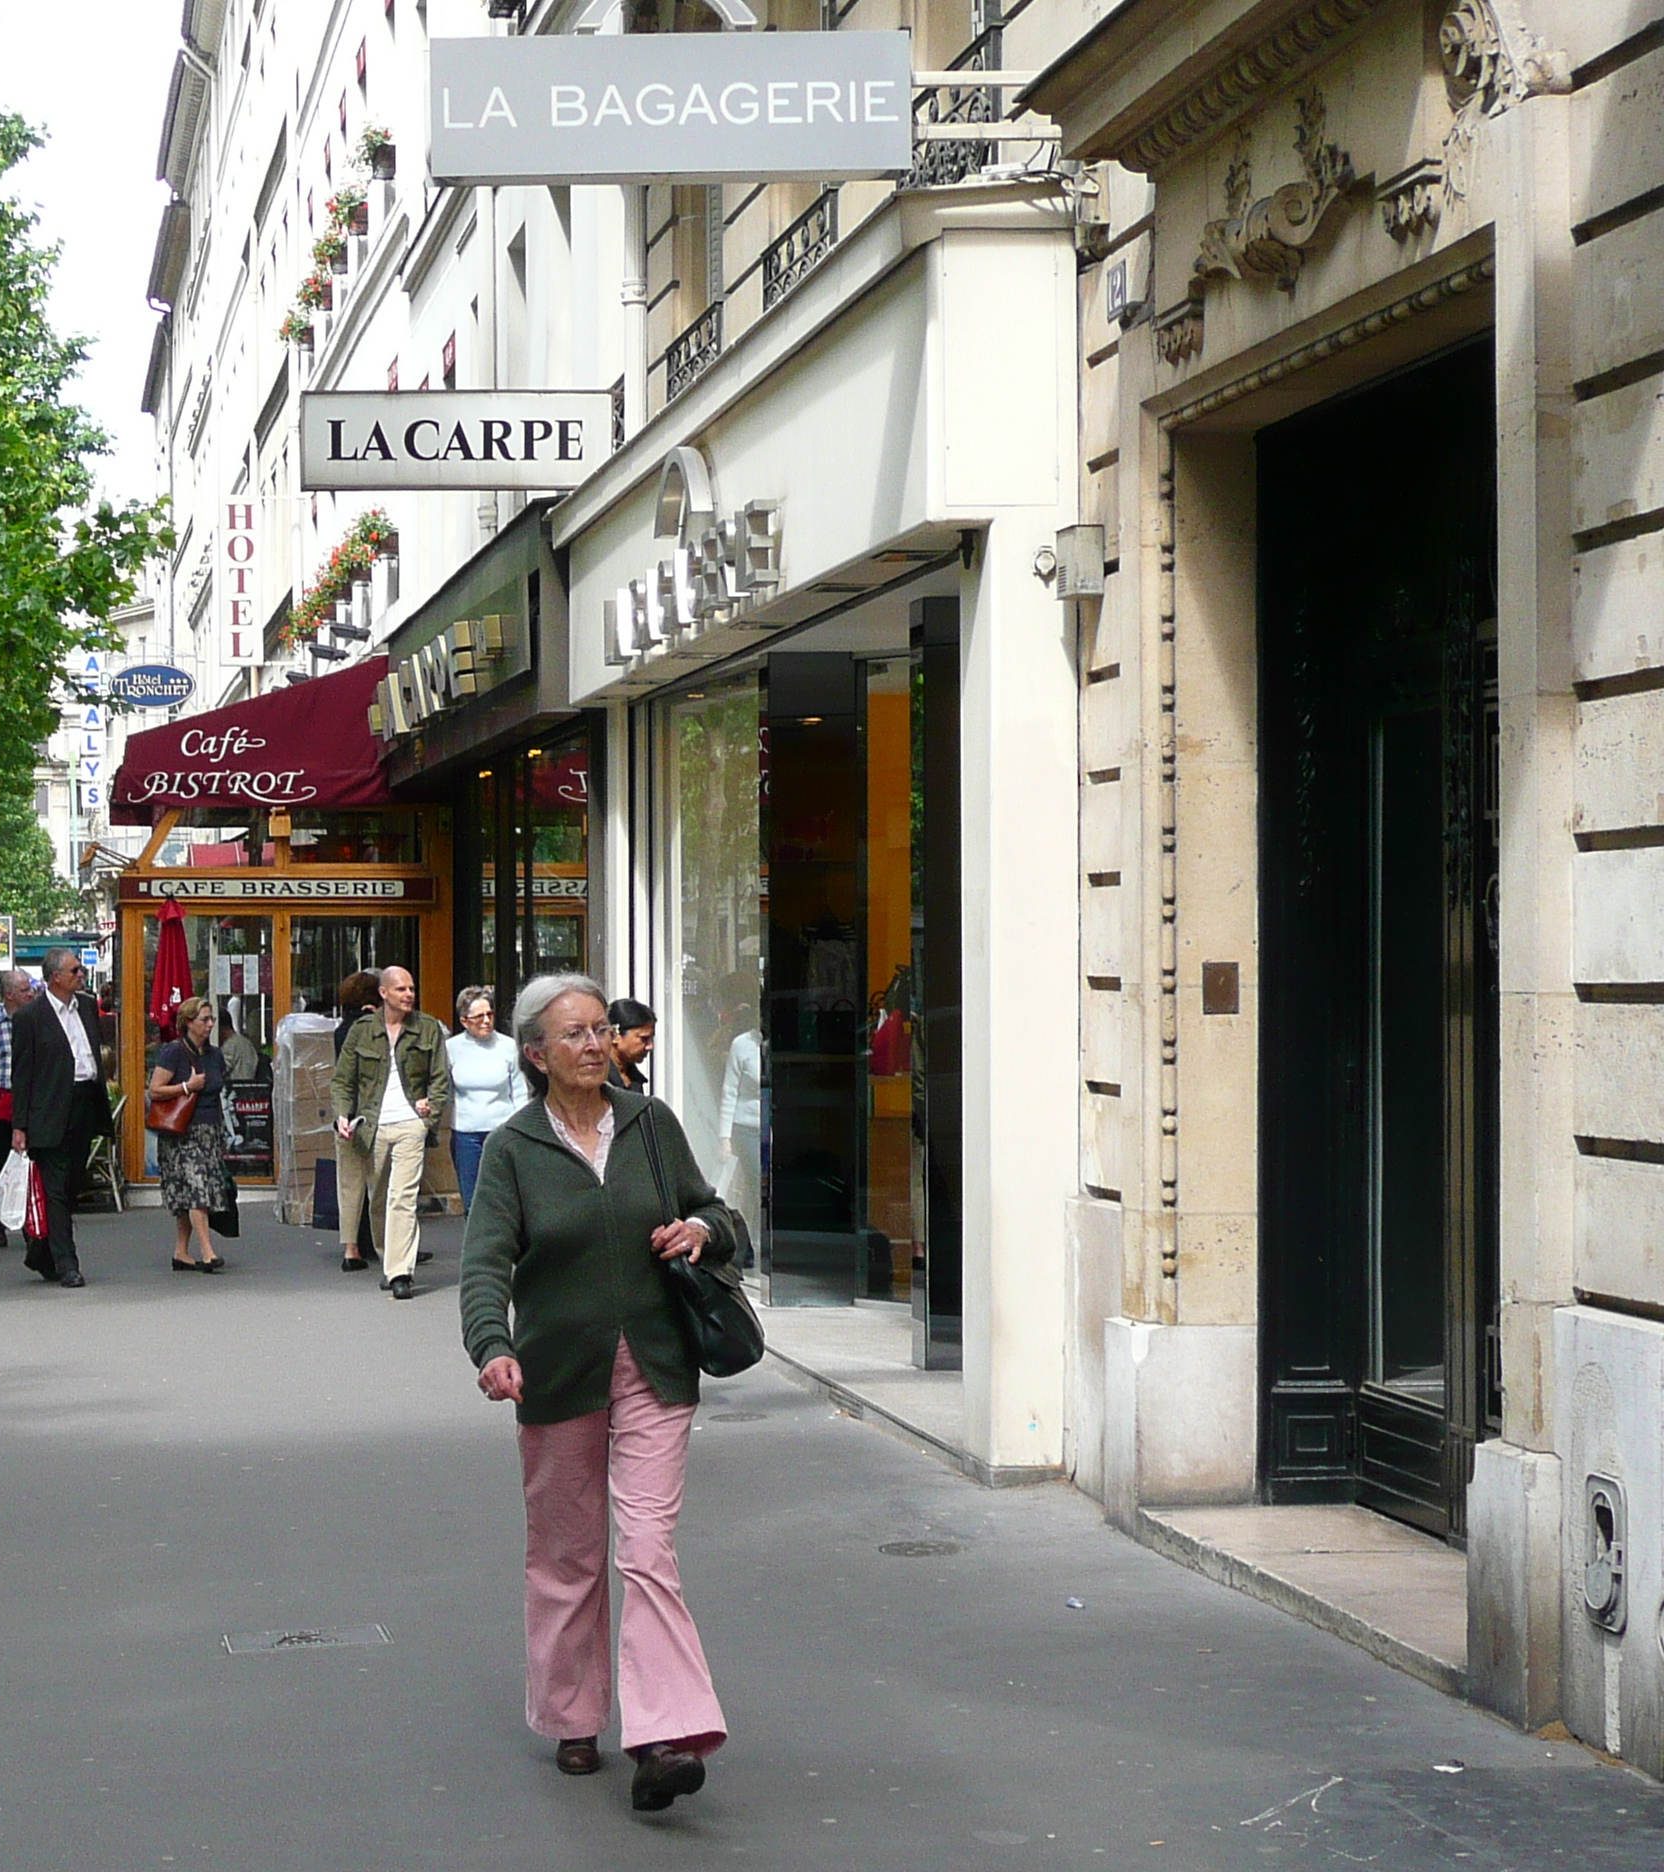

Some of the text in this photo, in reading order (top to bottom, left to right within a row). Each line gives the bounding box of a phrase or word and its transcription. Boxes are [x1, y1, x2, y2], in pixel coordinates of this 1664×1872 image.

[442, 80, 899, 129] LA BAGAGERIE
[326, 419, 584, 461] LA CARPE
[225, 503, 255, 658] HOTEL
[114, 673, 189, 698] Hôtel TRONCHET
[180, 726, 267, 763] Café
[127, 769, 318, 804] BISTROT
[158, 881, 397, 896] CAFE BRASSERIE
